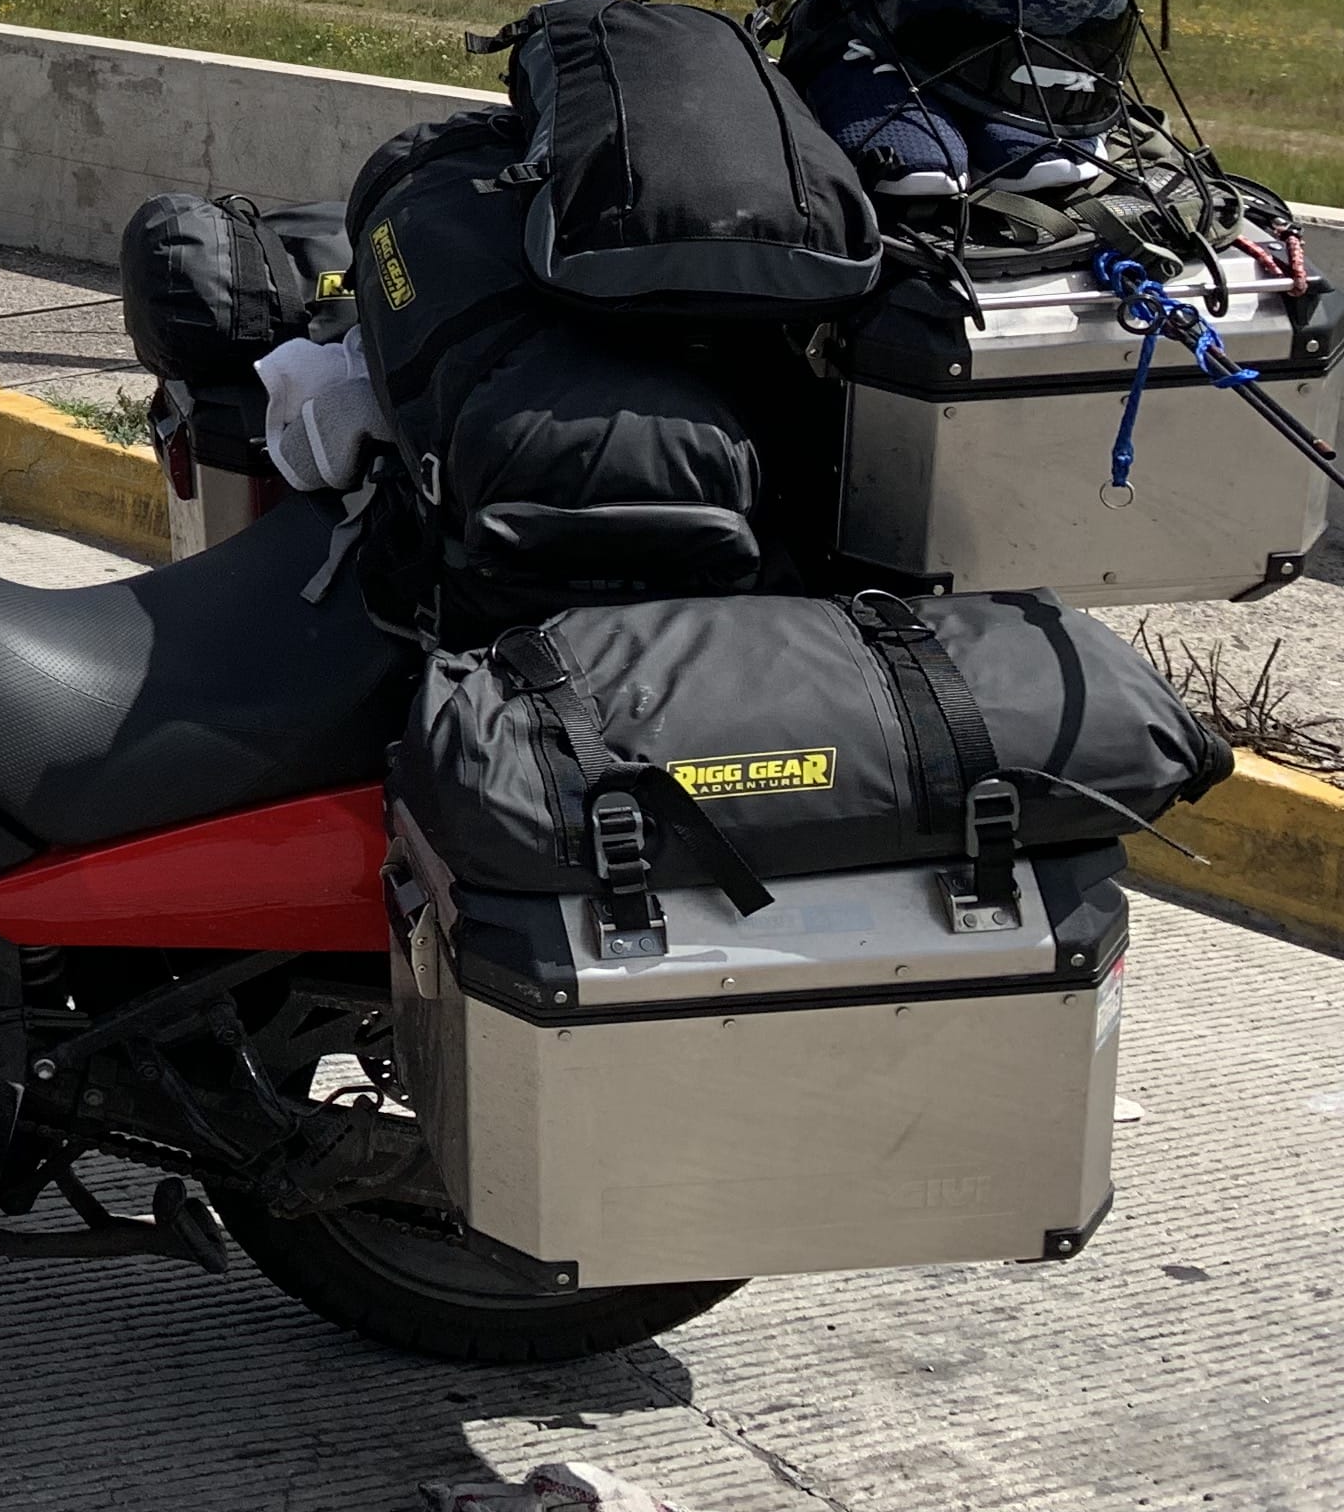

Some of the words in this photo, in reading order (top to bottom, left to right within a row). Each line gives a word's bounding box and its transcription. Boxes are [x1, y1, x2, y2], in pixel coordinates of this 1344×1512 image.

[386, 257, 413, 306] GEAR
[673, 764, 743, 795] RIGG
[748, 753, 829, 785] GEAR
[699, 776, 801, 794] ADVENTURE
